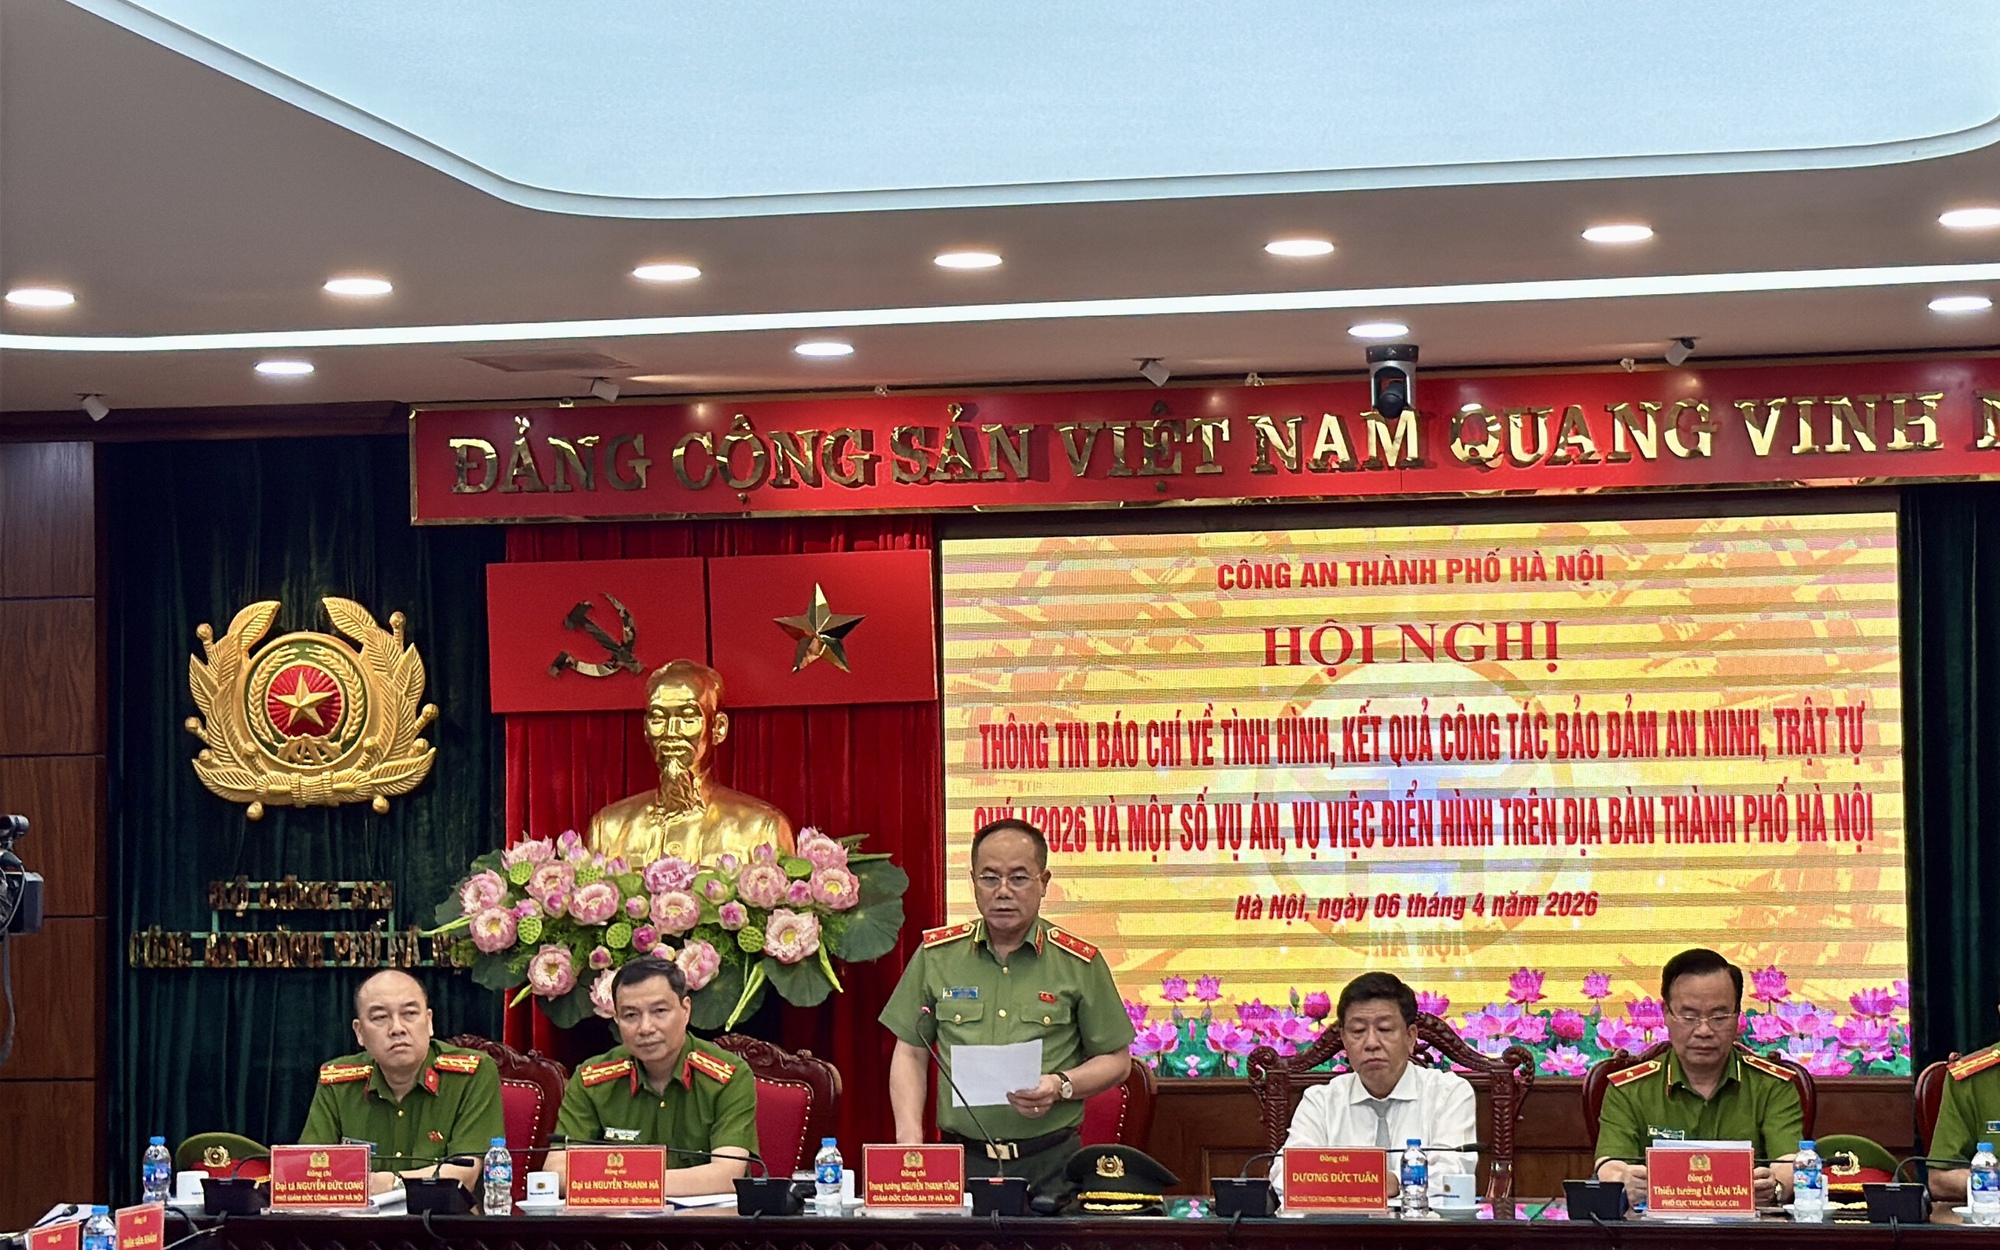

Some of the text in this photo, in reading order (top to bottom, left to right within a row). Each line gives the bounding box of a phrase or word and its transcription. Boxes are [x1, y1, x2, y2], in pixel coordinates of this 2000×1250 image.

[449, 415, 652, 494] ĐẢNG
[672, 414, 882, 503] CỘNG
[892, 402, 1033, 484] SẢN
[1054, 401, 1230, 493] VIỆT
[1248, 409, 1426, 474] NAM
[1449, 398, 1718, 469] QUANG
[1734, 391, 1944, 458] VINH
[1217, 548, 1604, 591] CÔNG AN THÀNH PHỐ HÀ NỘI
[1261, 618, 1562, 678] HỘI NGHỊ
[978, 693, 1866, 770] THÔNG TIN BÁO CHÍ VỀ TÌNH HÌNH, KẾT QUẢ CÔNG TÁC BẢO ĐẢM AN NINH, TRẬT TỰ
[1092, 796, 1121, 852] VÀ
[1127, 795, 1173, 863] MỘT
[1179, 786, 1209, 852] SỐ
[1214, 804, 1243, 862] VỤ
[1249, 793, 1286, 856] ÁN,
[1292, 802, 1320, 861] VỤ
[1326, 790, 1375, 860] VIỆC
[1381, 779, 1434, 848] ĐIỂN
[1440, 789, 1494, 847] HÌNH
[1499, 788, 1557, 846] TRÊN
[1563, 798, 1602, 858] ĐỊA
[1608, 787, 1655, 845] BÀN
[1661, 786, 1736, 844] THÀNH
[1743, 778, 1789, 843] PHỐ
[1796, 783, 1828, 842] HÀ
[1834, 783, 1874, 854] NỘI
[1235, 891, 1599, 926] Hà Nội, ngày 06 tháng 4 năm 2026
[296, 1178, 326, 1191] NGUYỄN
[344, 1181, 364, 1191] LONG
[1292, 1171, 1379, 1183] DƯƠNG ĐỨC TUẤN
